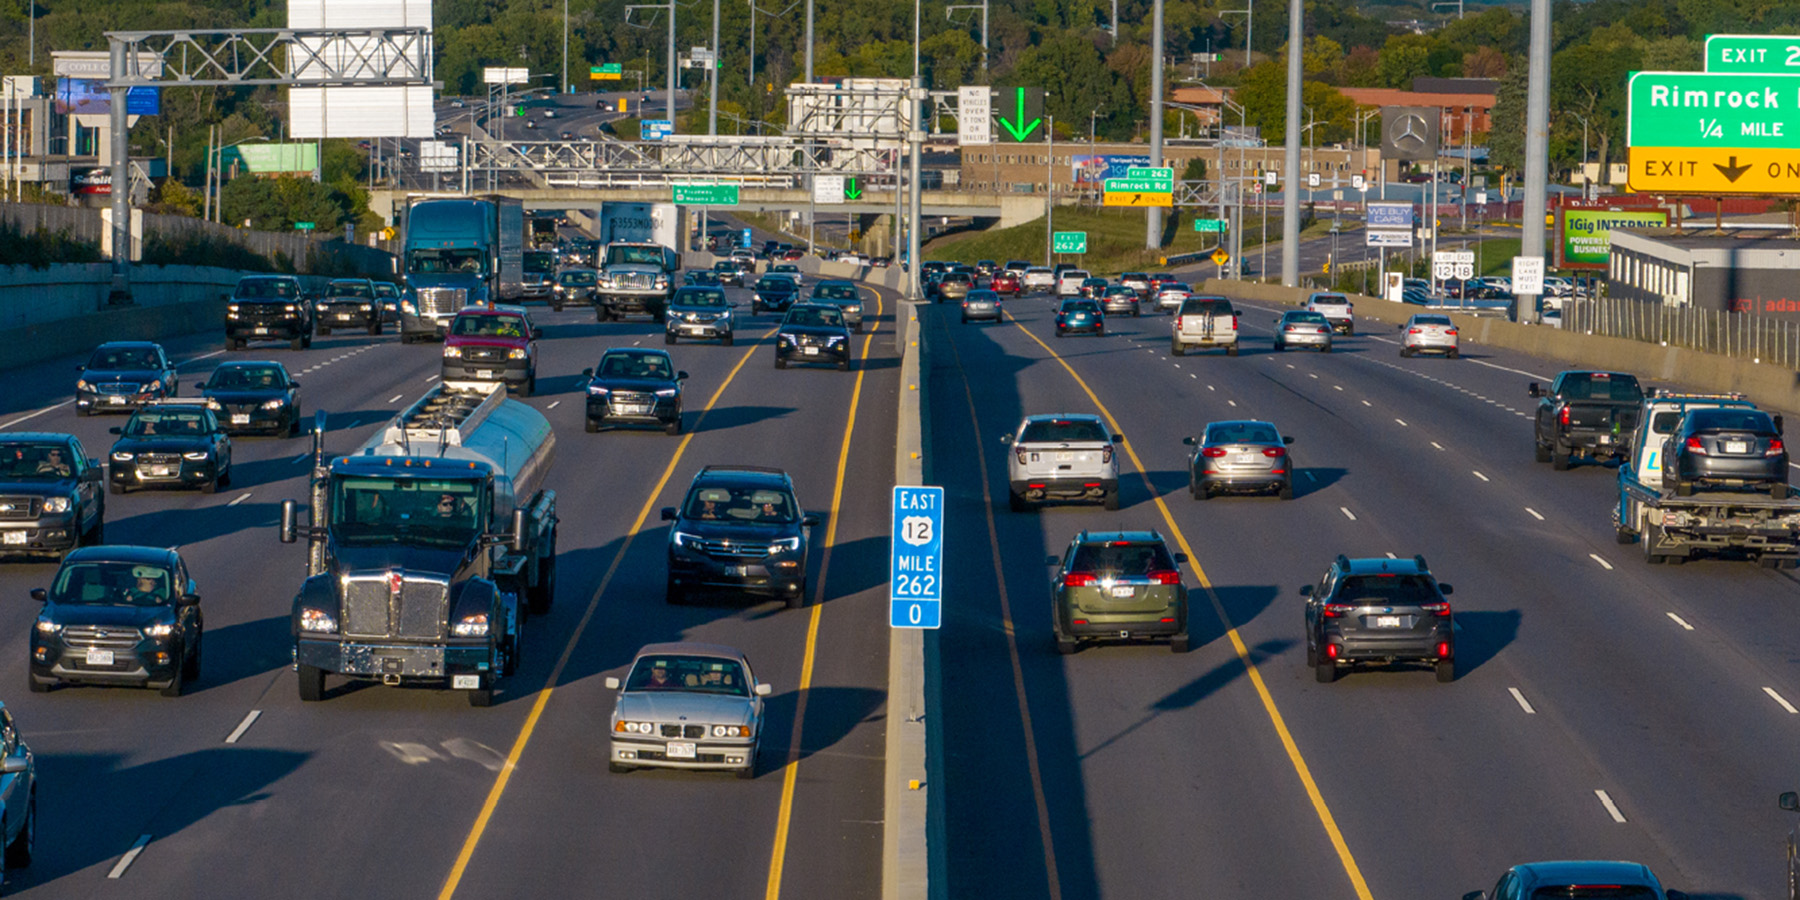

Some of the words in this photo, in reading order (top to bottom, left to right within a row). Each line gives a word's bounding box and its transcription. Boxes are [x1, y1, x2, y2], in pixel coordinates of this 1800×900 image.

[1722, 48, 1767, 63] EXIT
[1651, 85, 1779, 108] Rimrock
[1741, 122, 1784, 137] MILE
[1645, 160, 1698, 177] EXIT
[1110, 182, 1150, 190] Rimrock
[1154, 182, 1167, 190] Rd
[1569, 219, 1594, 234] 1Gig
[1056, 242, 1074, 250] 262
[1439, 267, 1451, 276] 12
[1458, 267, 1470, 276] 18
[1766, 298, 1800, 312] ada
[901, 491, 935, 510] EAST
[907, 522, 929, 539] 12
[899, 555, 934, 571] MILE
[897, 574, 935, 596] 262
[909, 604, 921, 624] 0
